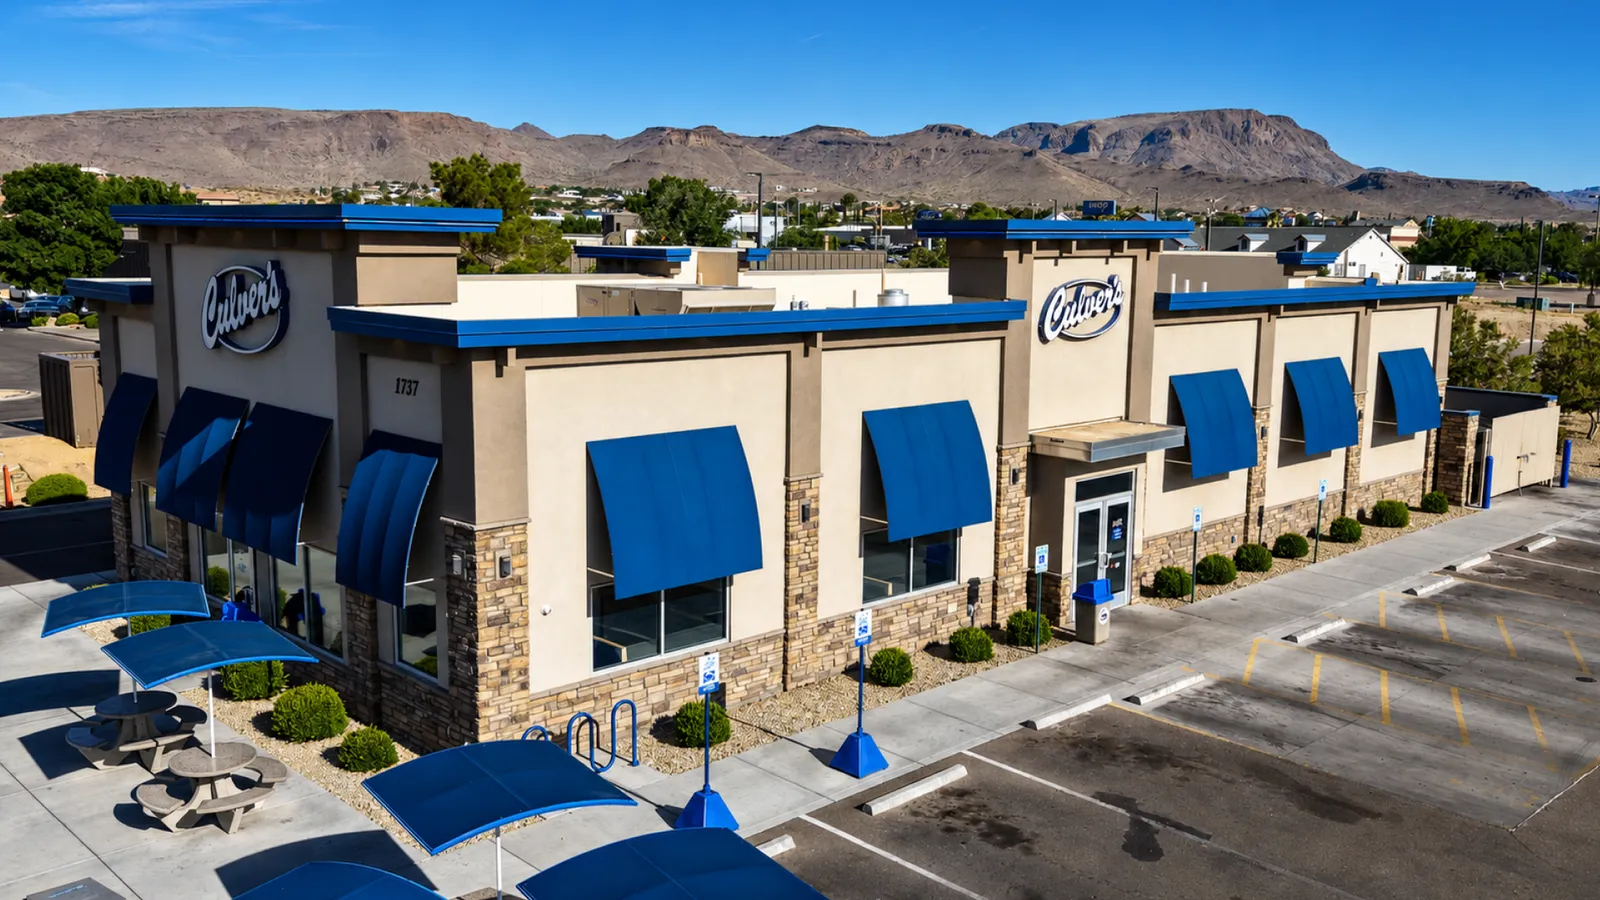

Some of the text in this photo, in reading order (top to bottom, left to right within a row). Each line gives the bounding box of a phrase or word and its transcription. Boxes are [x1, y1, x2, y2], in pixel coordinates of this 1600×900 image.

[202, 260, 281, 349] Culver's
[1043, 274, 1124, 342] Culver's
[395, 376, 420, 397] 1737
